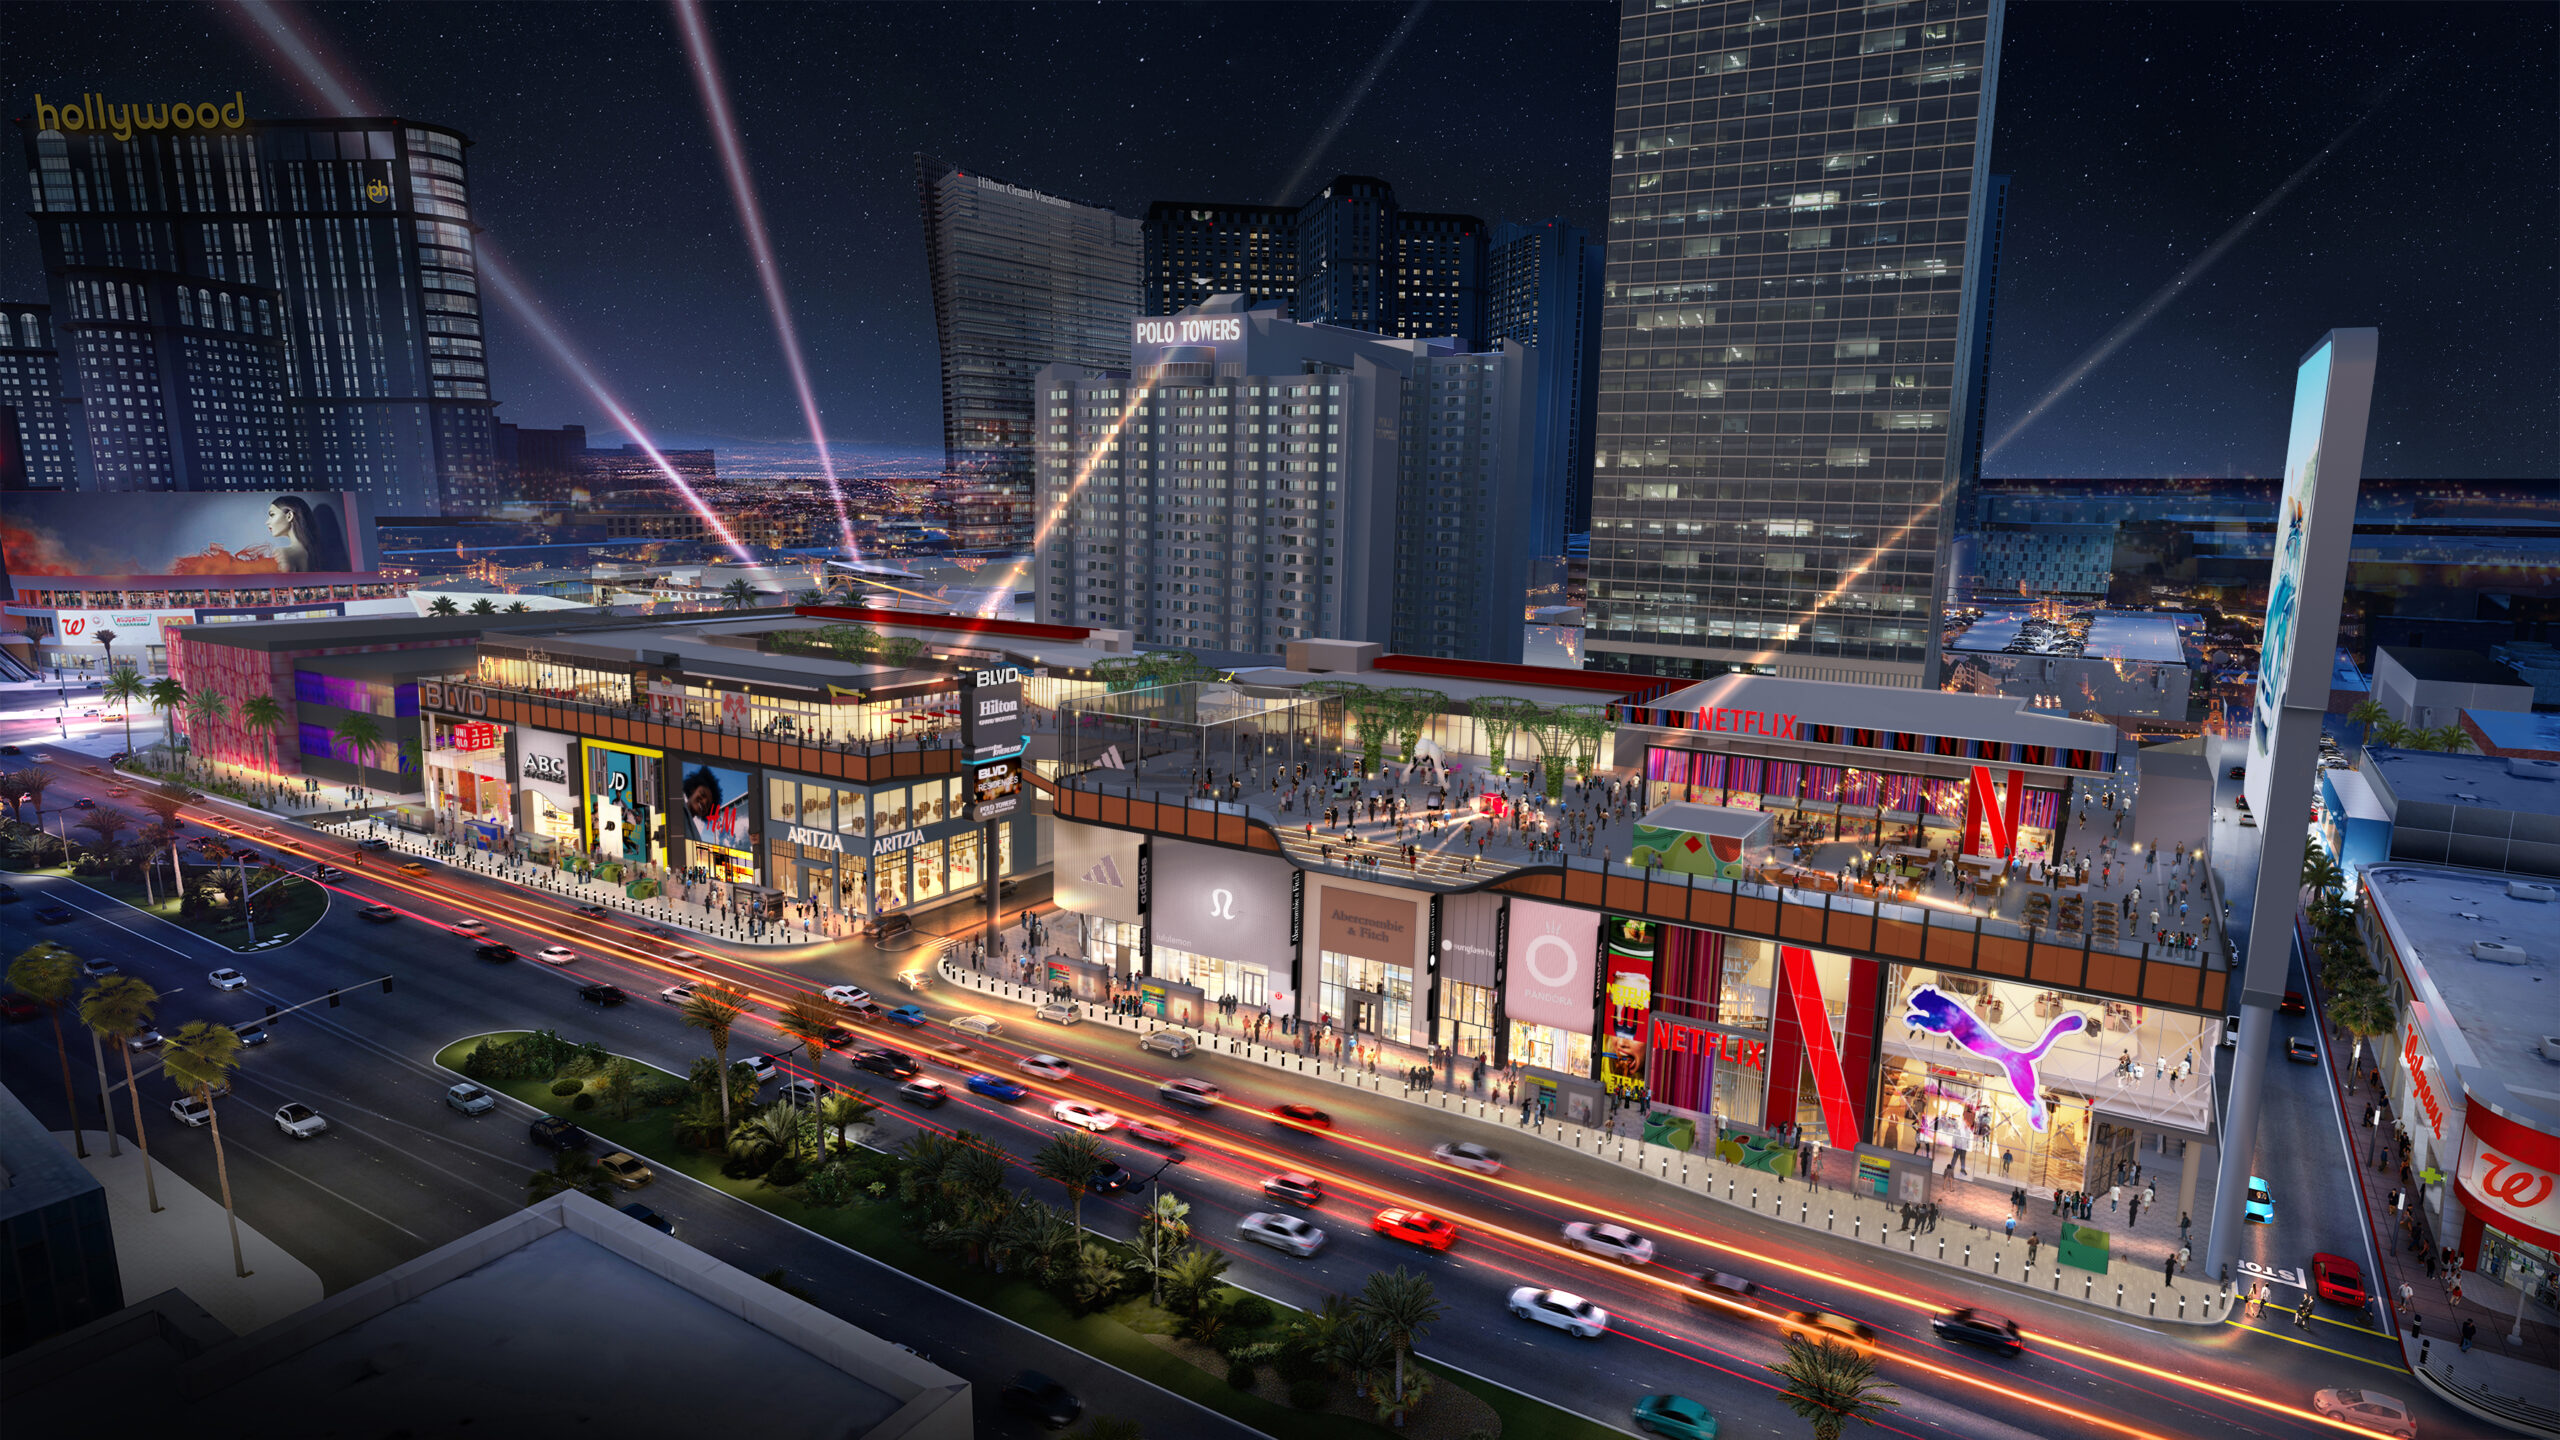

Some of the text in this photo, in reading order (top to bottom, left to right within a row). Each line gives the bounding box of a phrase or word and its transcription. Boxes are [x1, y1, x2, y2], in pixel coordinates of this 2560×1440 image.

[35, 91, 245, 142] hollywood
[977, 175, 1071, 209] Hilton Grand Vacations
[1136, 318, 1241, 344] POLO TOWERS
[976, 667, 1019, 688] BLVD
[425, 682, 488, 716] BLVD
[979, 699, 1018, 717] Hilton
[455, 727, 467, 737] UNI
[1698, 706, 1798, 741] NETFLIX
[456, 737, 468, 748] QLO
[524, 752, 565, 775] ABC
[977, 764, 1008, 780] BLVD
[608, 772, 625, 791] JD
[705, 803, 737, 837] H&M
[787, 825, 845, 853] ARITZIA
[872, 829, 925, 856] ARITZIA
[1139, 857, 1148, 905] adidas
[1331, 909, 1405, 933] Abercrombie
[1156, 932, 1192, 948] lululemon
[1347, 926, 1390, 944] & Fitch
[1453, 943, 1485, 956] sunglass
[1524, 988, 1574, 1007] PANDORA
[1606, 982, 1652, 1001] NETFLIX
[1612, 994, 1646, 1010] BITES
[1652, 1019, 1766, 1072] NETFLIX
[2404, 1023, 2443, 1140] Walgreens
